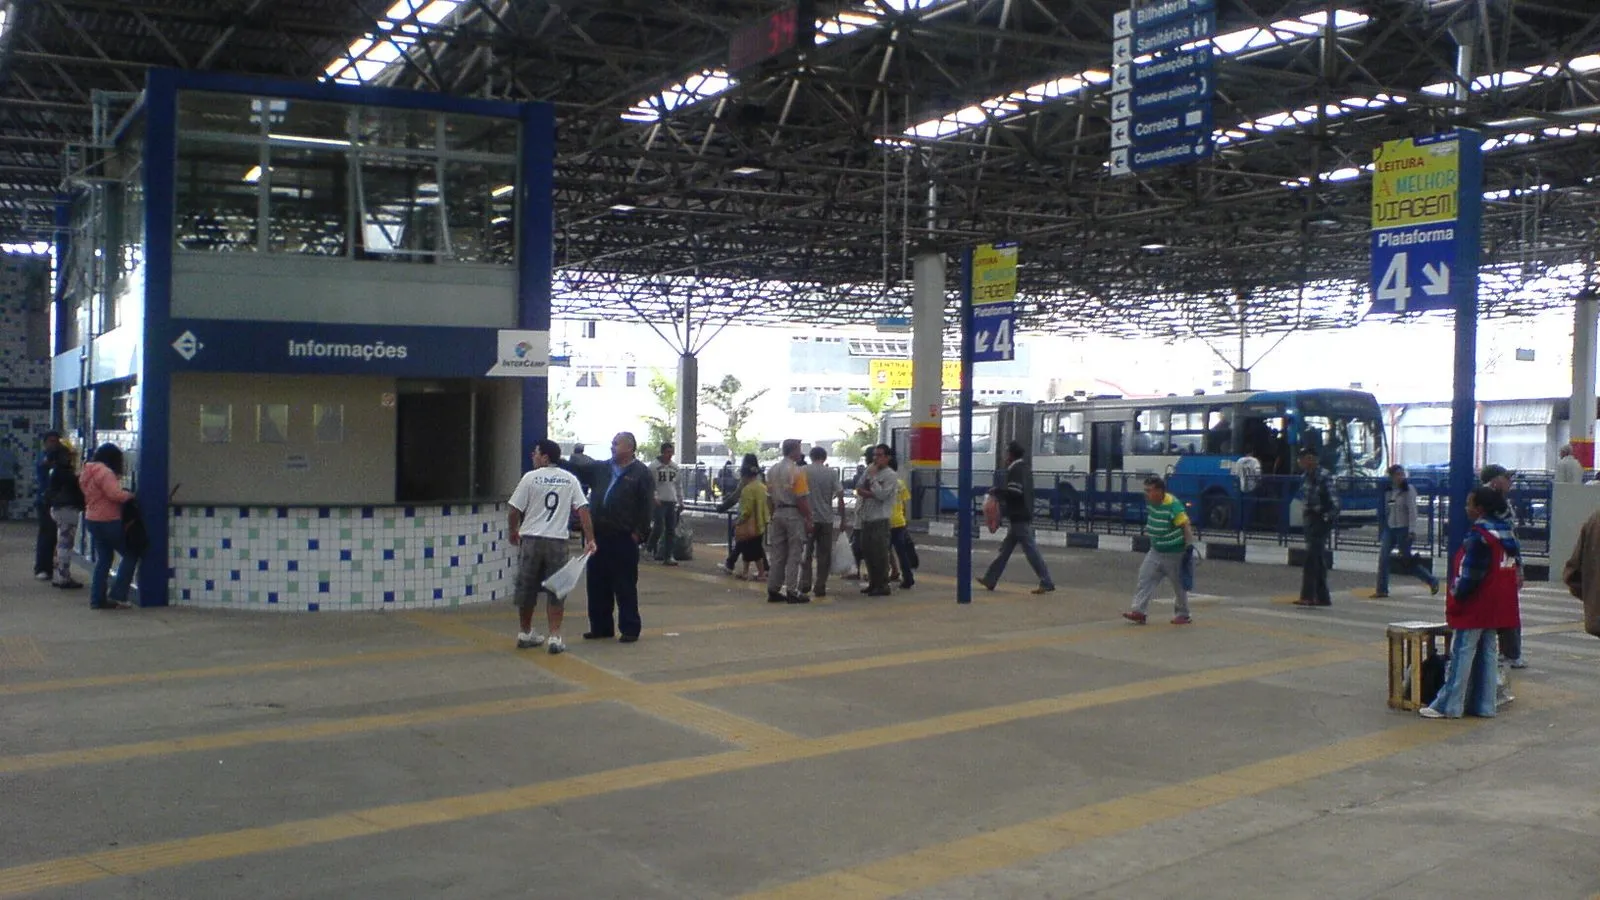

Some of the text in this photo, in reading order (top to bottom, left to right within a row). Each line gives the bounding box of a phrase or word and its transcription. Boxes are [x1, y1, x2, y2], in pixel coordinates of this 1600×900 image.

[1136, 0, 1189, 25] Bilheteria
[1136, 26, 1190, 52] Sanitários
[1135, 54, 1194, 79] Informações
[1134, 117, 1179, 137] Correios
[1378, 156, 1425, 172] LEITURA
[1396, 169, 1456, 195] MELHOR
[1378, 228, 1455, 248] Plataforma
[1377, 252, 1412, 311] 4
[288, 339, 408, 361] Informações
[993, 319, 1012, 359] 4
[545, 491, 559, 522] 9
